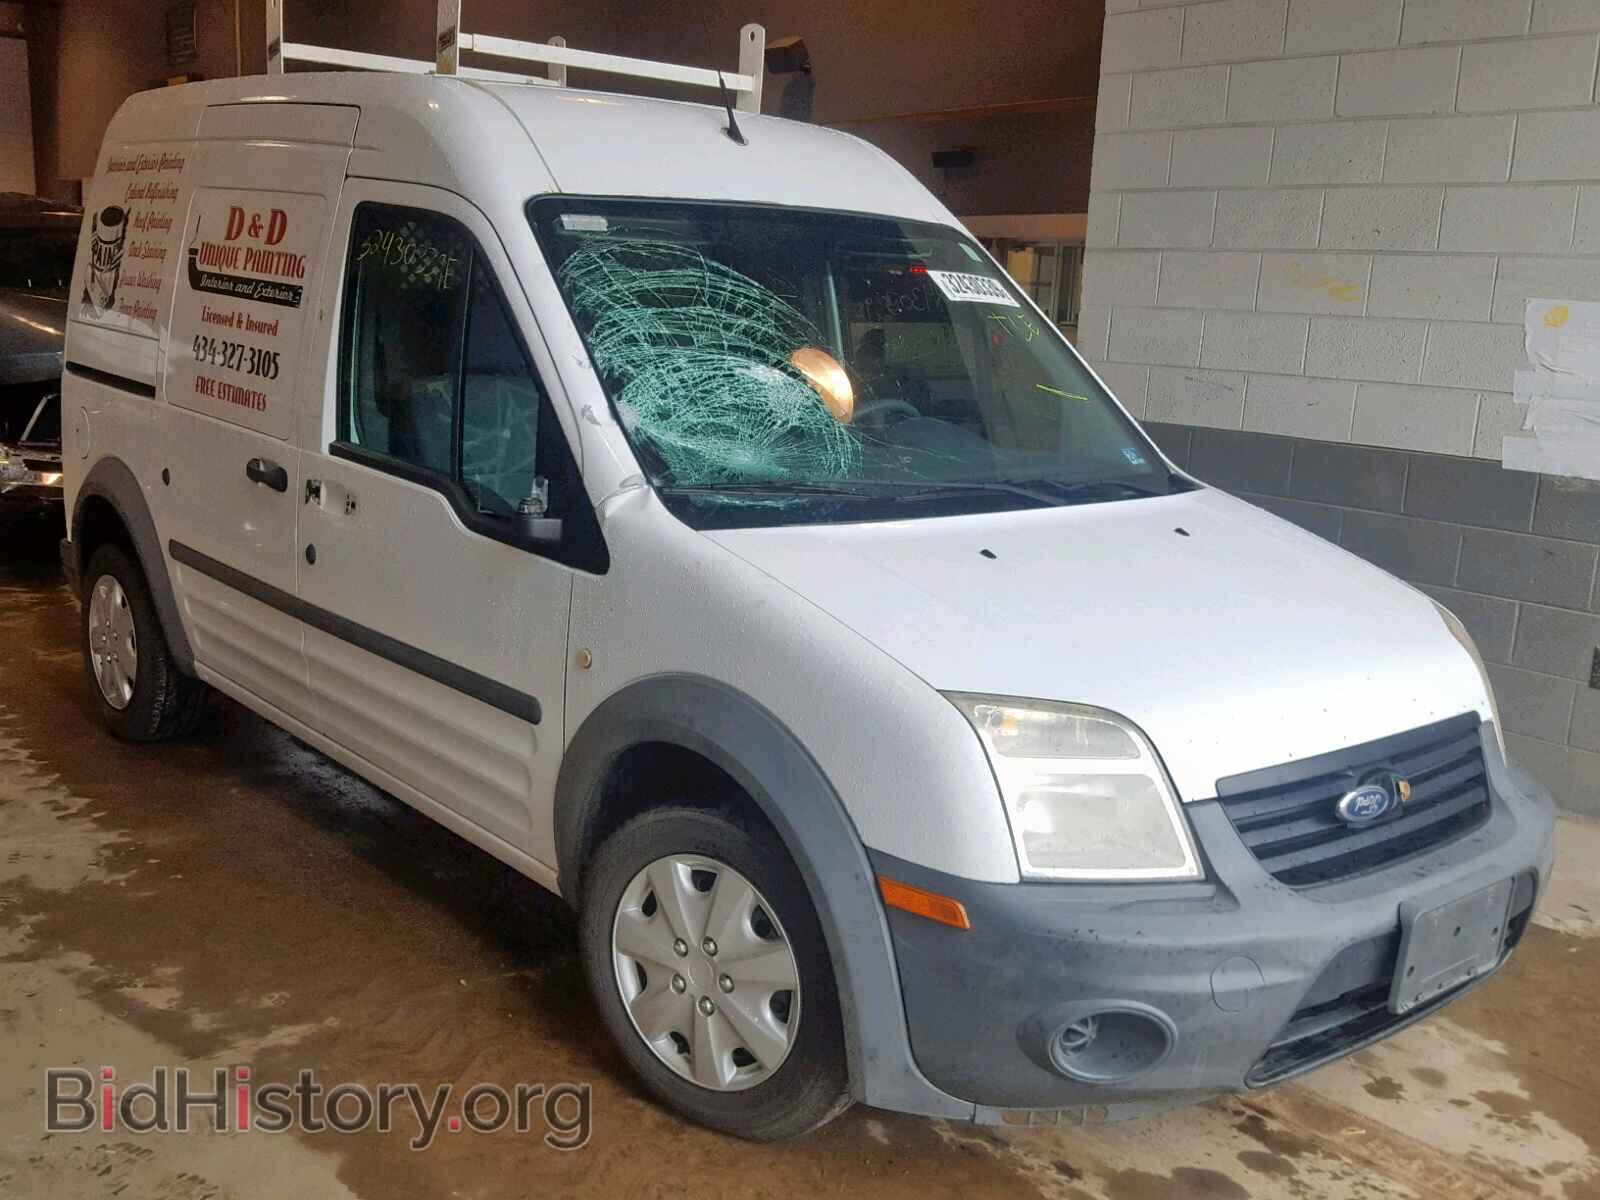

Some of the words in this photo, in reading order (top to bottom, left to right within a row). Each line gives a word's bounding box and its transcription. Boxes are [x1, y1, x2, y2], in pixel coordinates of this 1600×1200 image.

[224, 205, 245, 241] D
[248, 213, 264, 239] &
[264, 208, 288, 246] D
[199, 240, 242, 273] UNIQUE
[242, 246, 307, 279] PAINTING
[200, 273, 235, 291] Interior
[234, 280, 256, 296] and
[201, 305, 235, 329] Licensed
[236, 312, 245, 329] &
[245, 314, 280, 337] Insured
[192, 334, 281, 381] 434-327-3105
[195, 375, 217, 399] FREE
[217, 381, 268, 413] ESTIMATES
